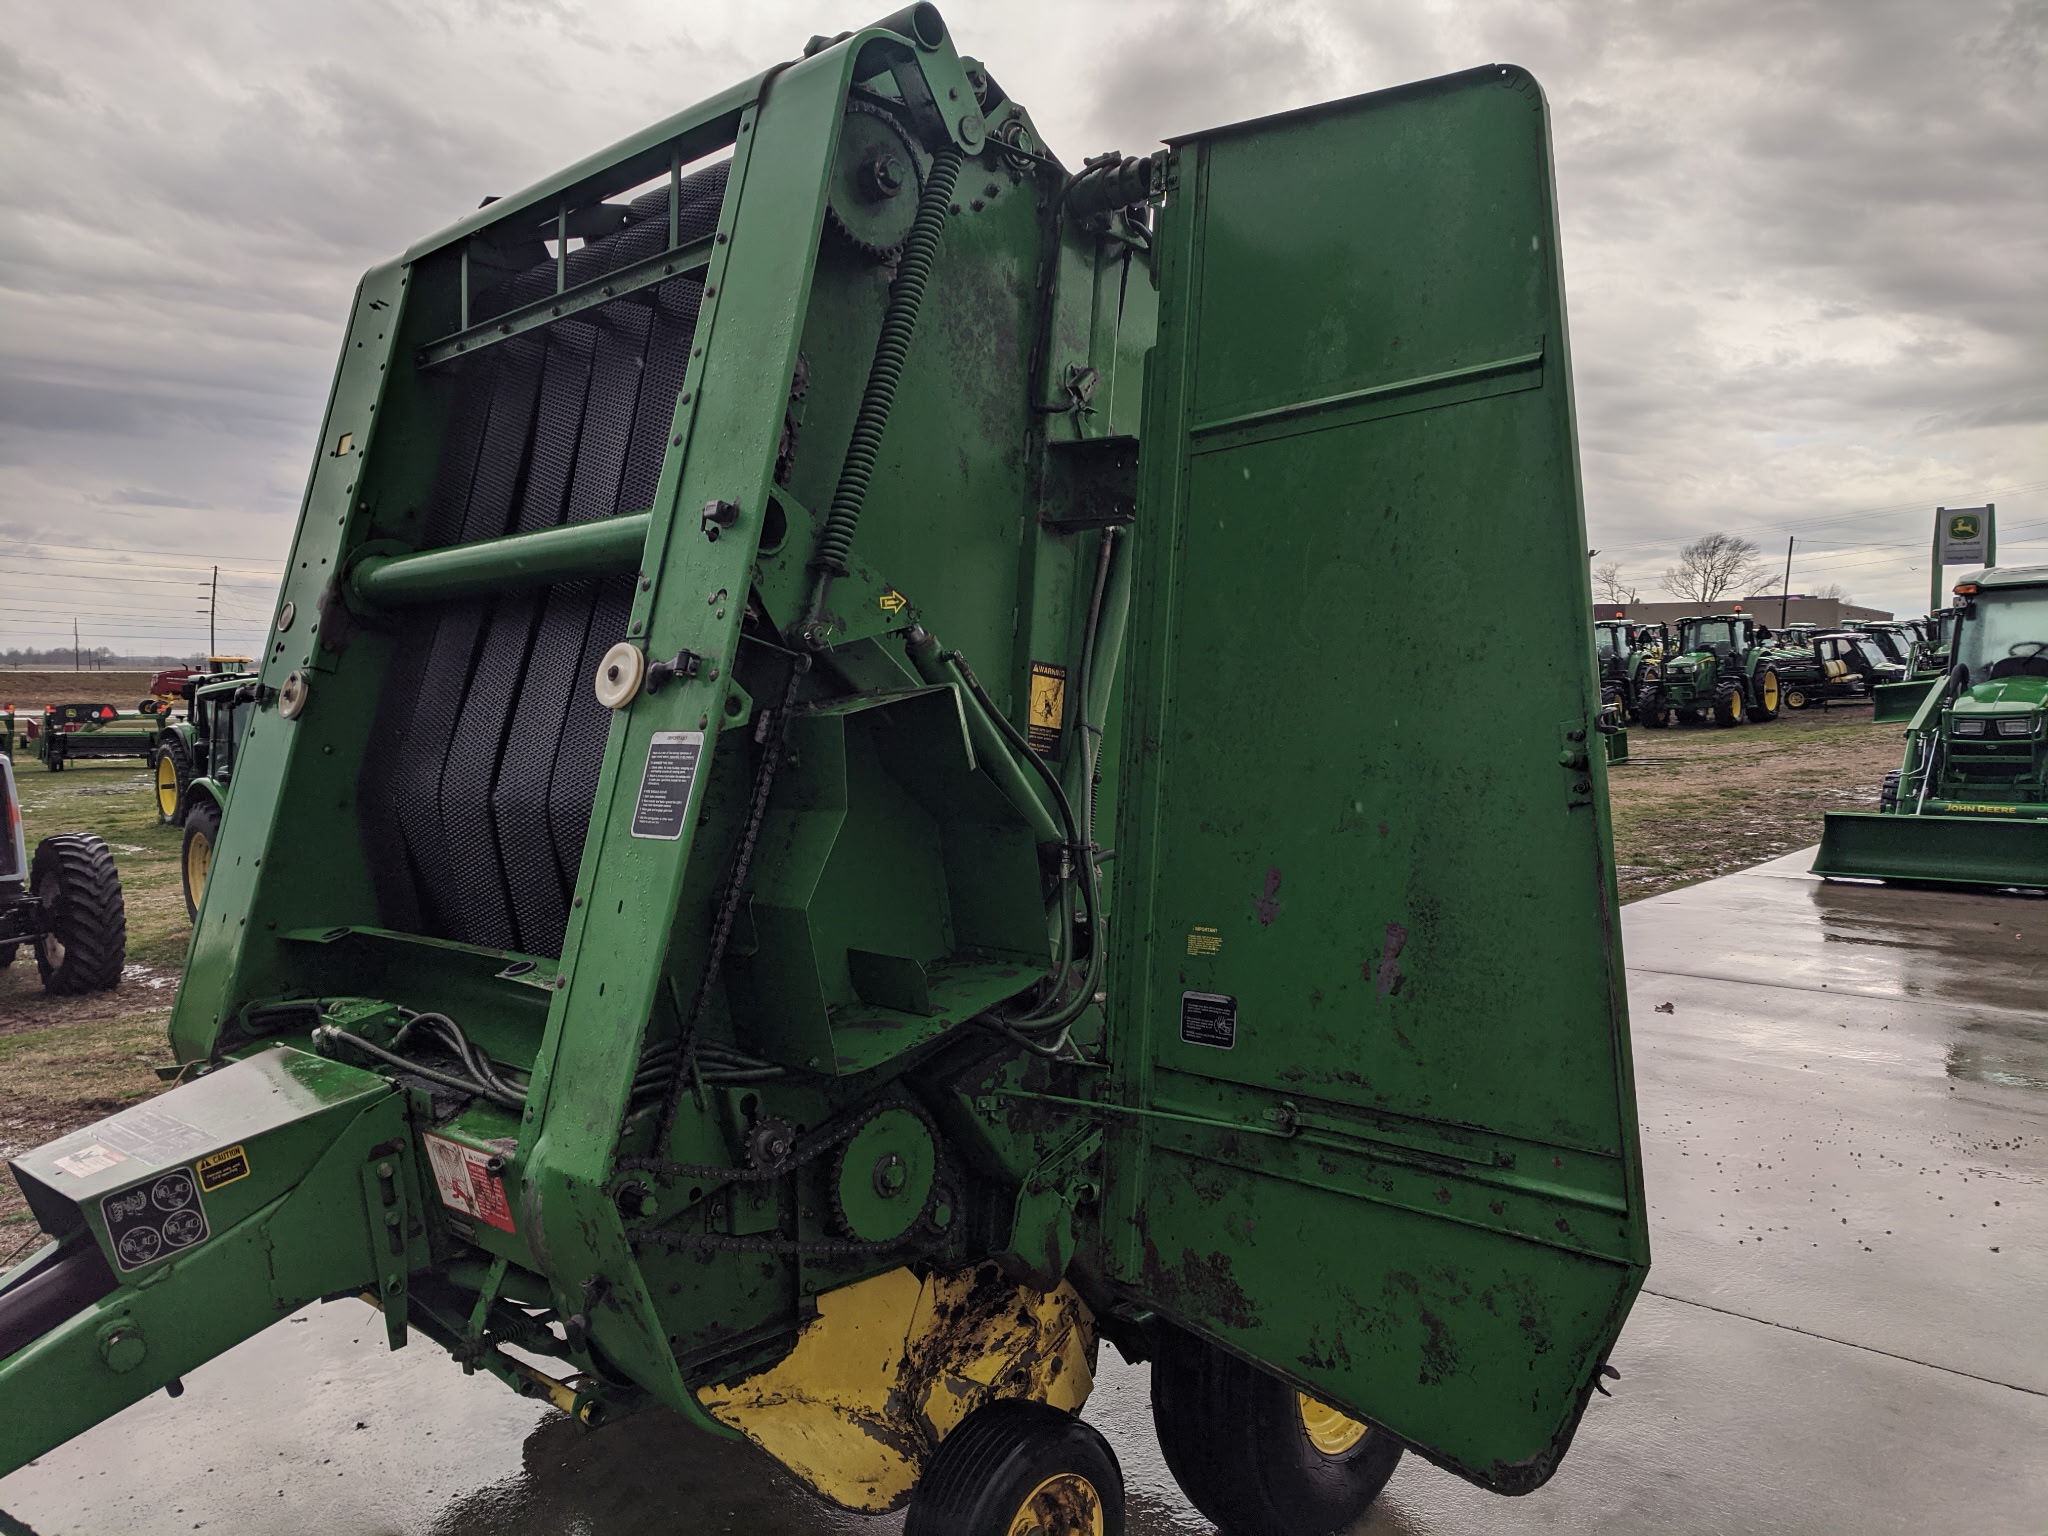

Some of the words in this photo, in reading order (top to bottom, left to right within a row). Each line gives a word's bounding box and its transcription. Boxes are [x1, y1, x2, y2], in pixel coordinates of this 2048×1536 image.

[1039, 665, 1066, 677] WARNING
[1944, 803, 1976, 812] JOHN
[1977, 804, 2017, 814] DEERE
[212, 1147, 241, 1163] CAUTION
